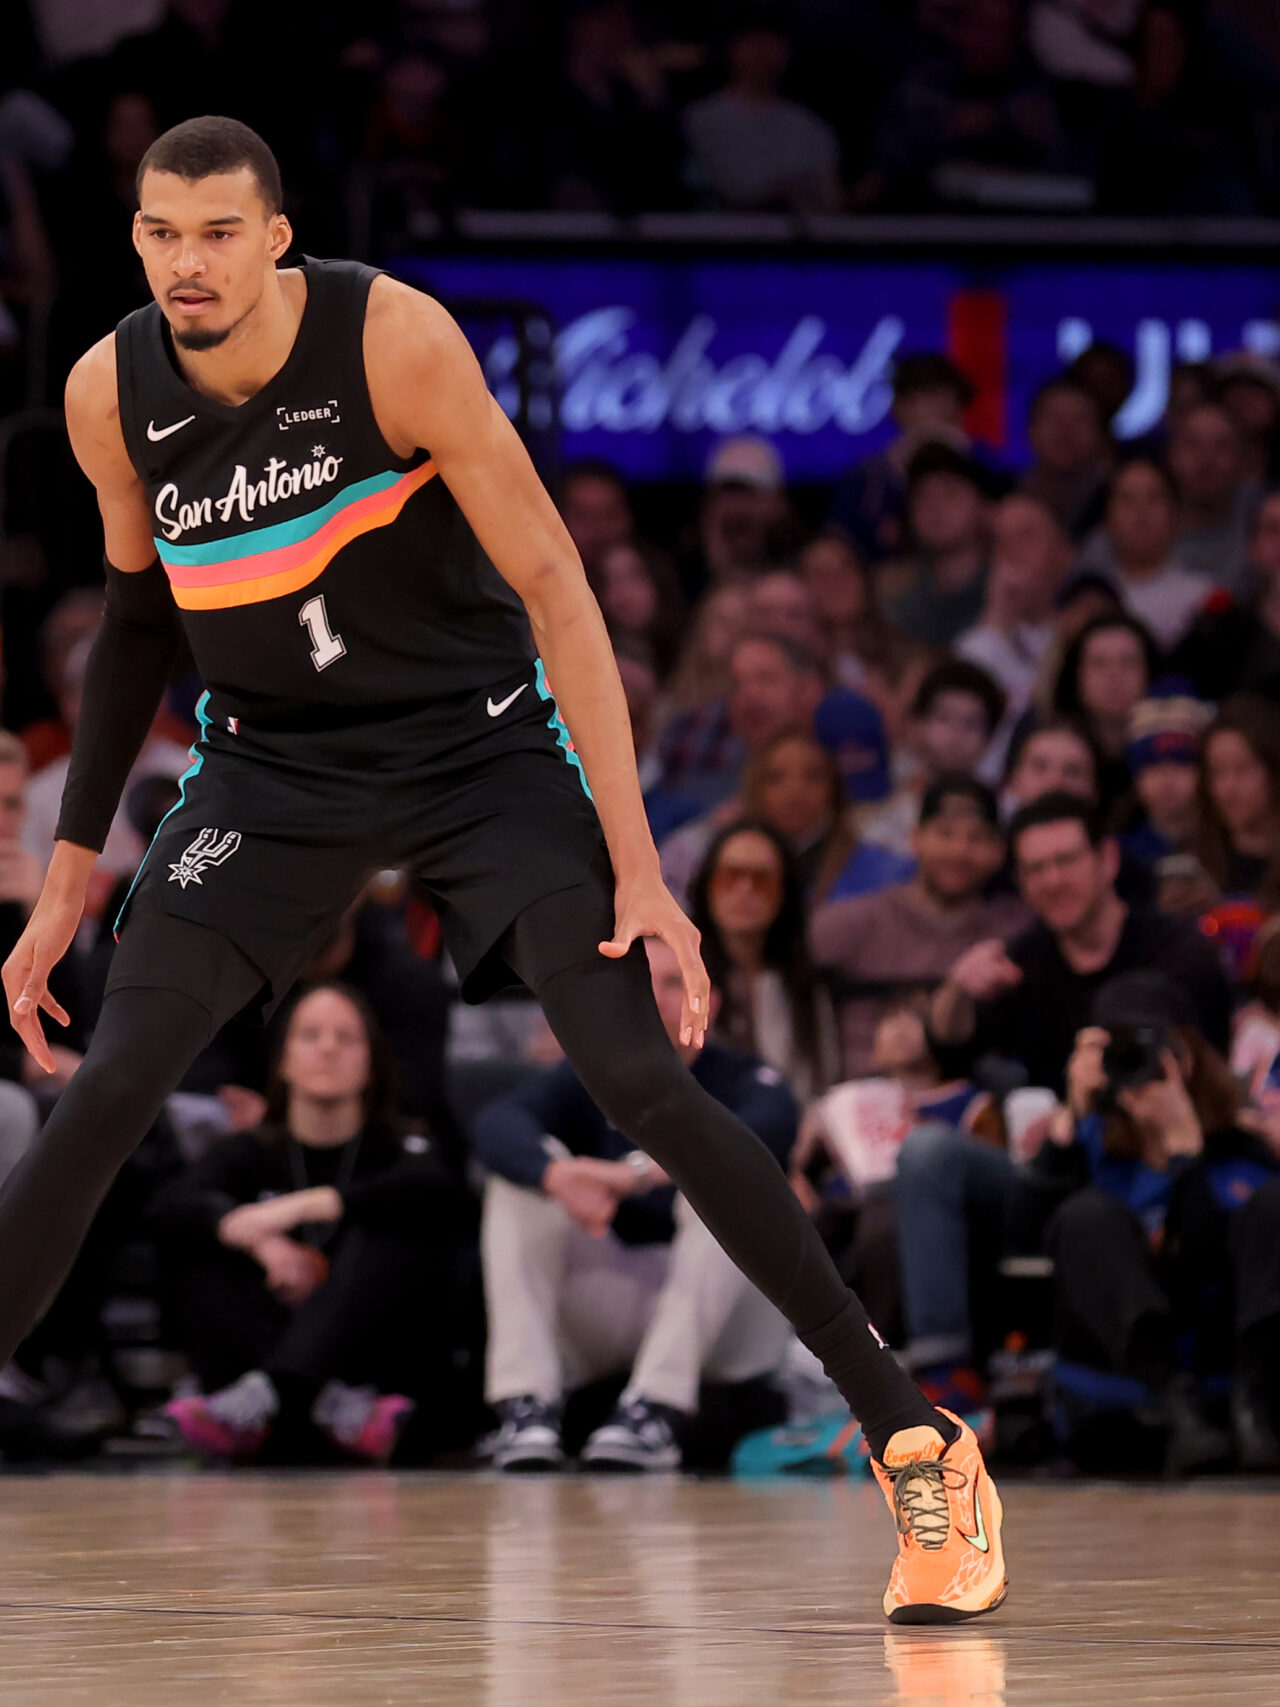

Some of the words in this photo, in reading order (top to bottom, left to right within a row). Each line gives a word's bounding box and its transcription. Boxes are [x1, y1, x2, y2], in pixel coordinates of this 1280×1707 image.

[284, 407, 331, 424] LEDGER
[155, 482, 213, 541] San
[215, 445, 343, 522] Antonio
[298, 594, 347, 672] 1
